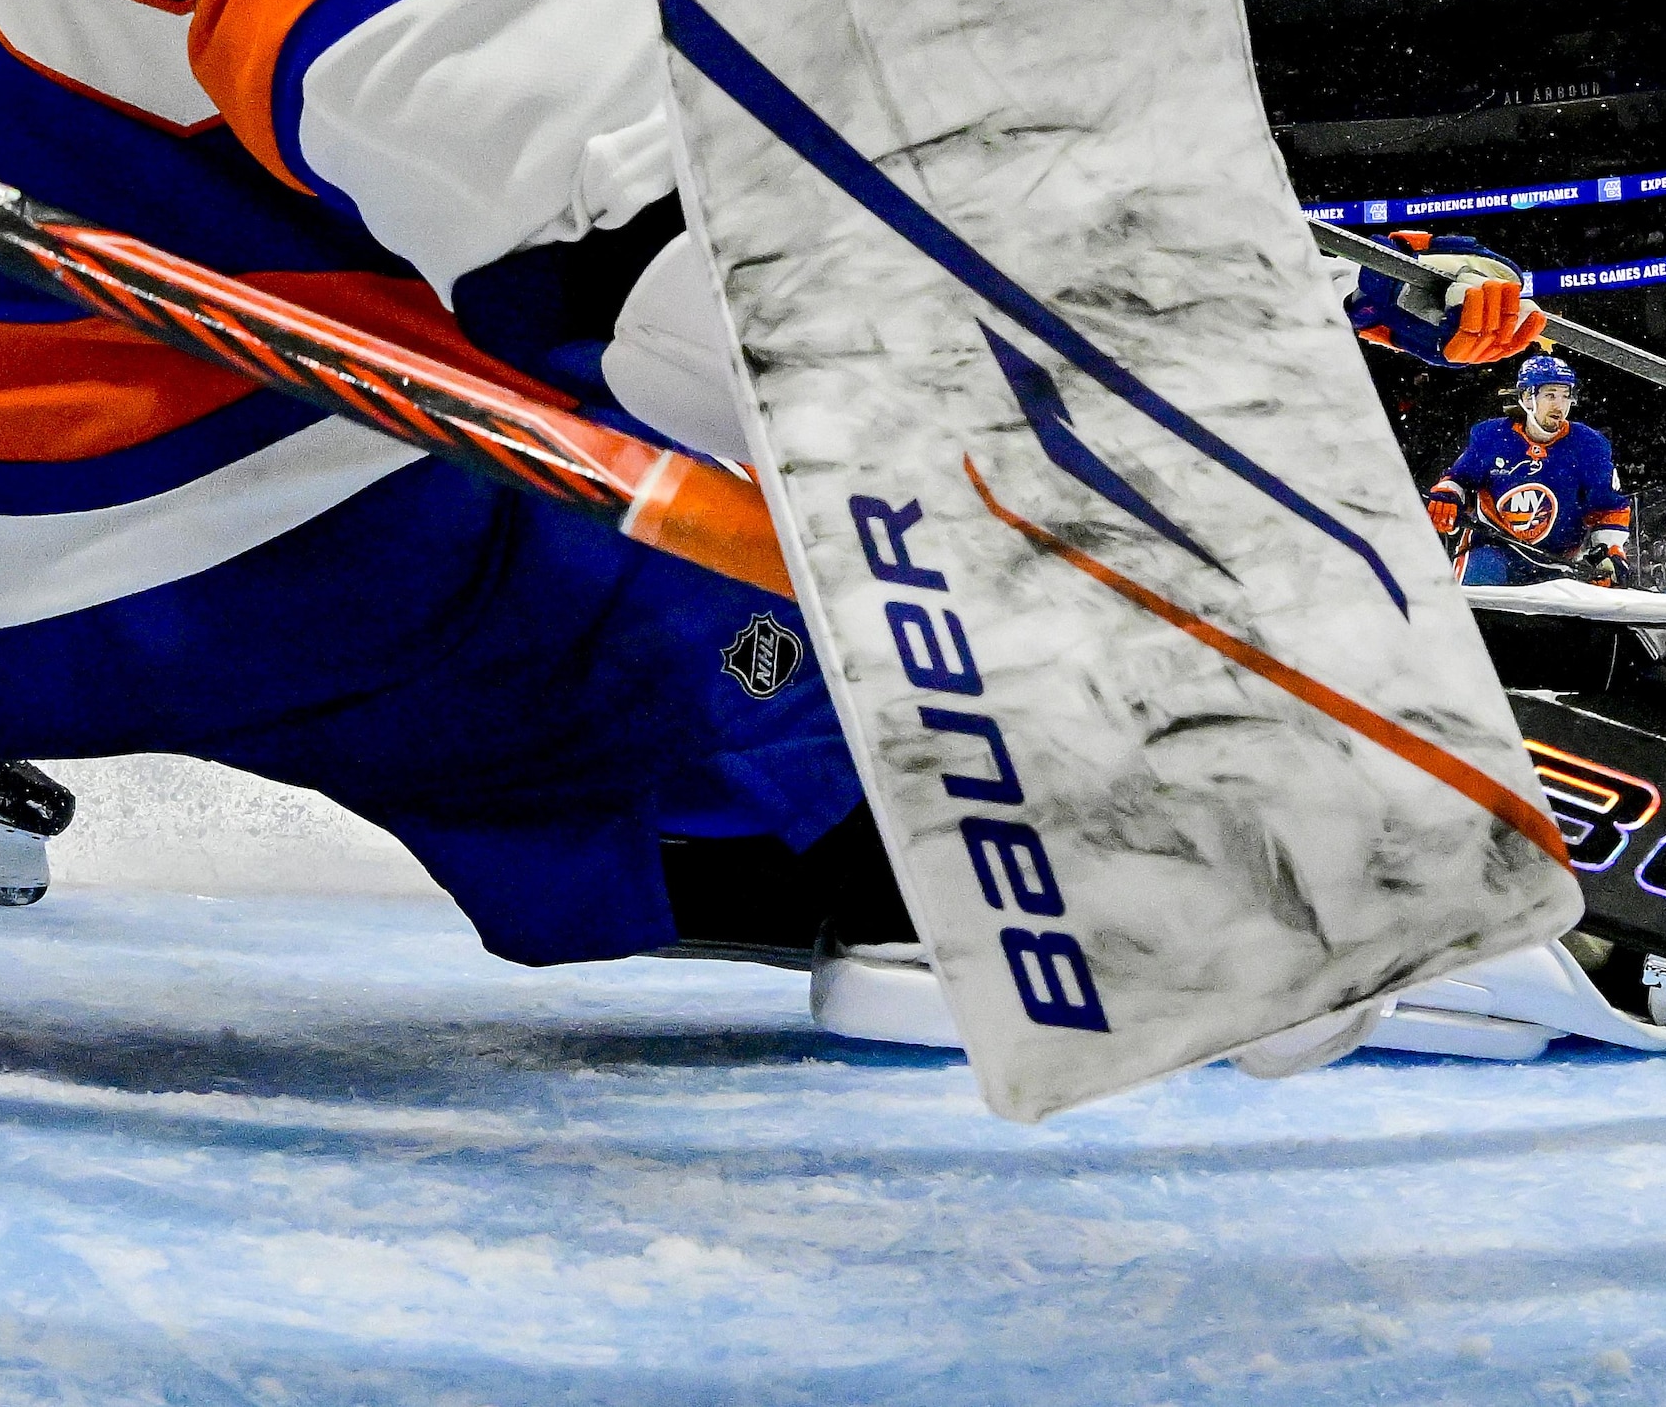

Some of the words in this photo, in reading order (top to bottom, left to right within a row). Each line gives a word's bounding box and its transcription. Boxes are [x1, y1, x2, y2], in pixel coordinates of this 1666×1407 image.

[1406, 198, 1475, 216] EXPERIENCE
[1476, 194, 1508, 209] MORE
[1510, 187, 1579, 207] #WITHAMEX
[1560, 271, 1597, 288] ISLES
[1600, 268, 1640, 285] GAMES
[1643, 262, 1666, 278] ARE
[756, 633, 775, 686] NHL
